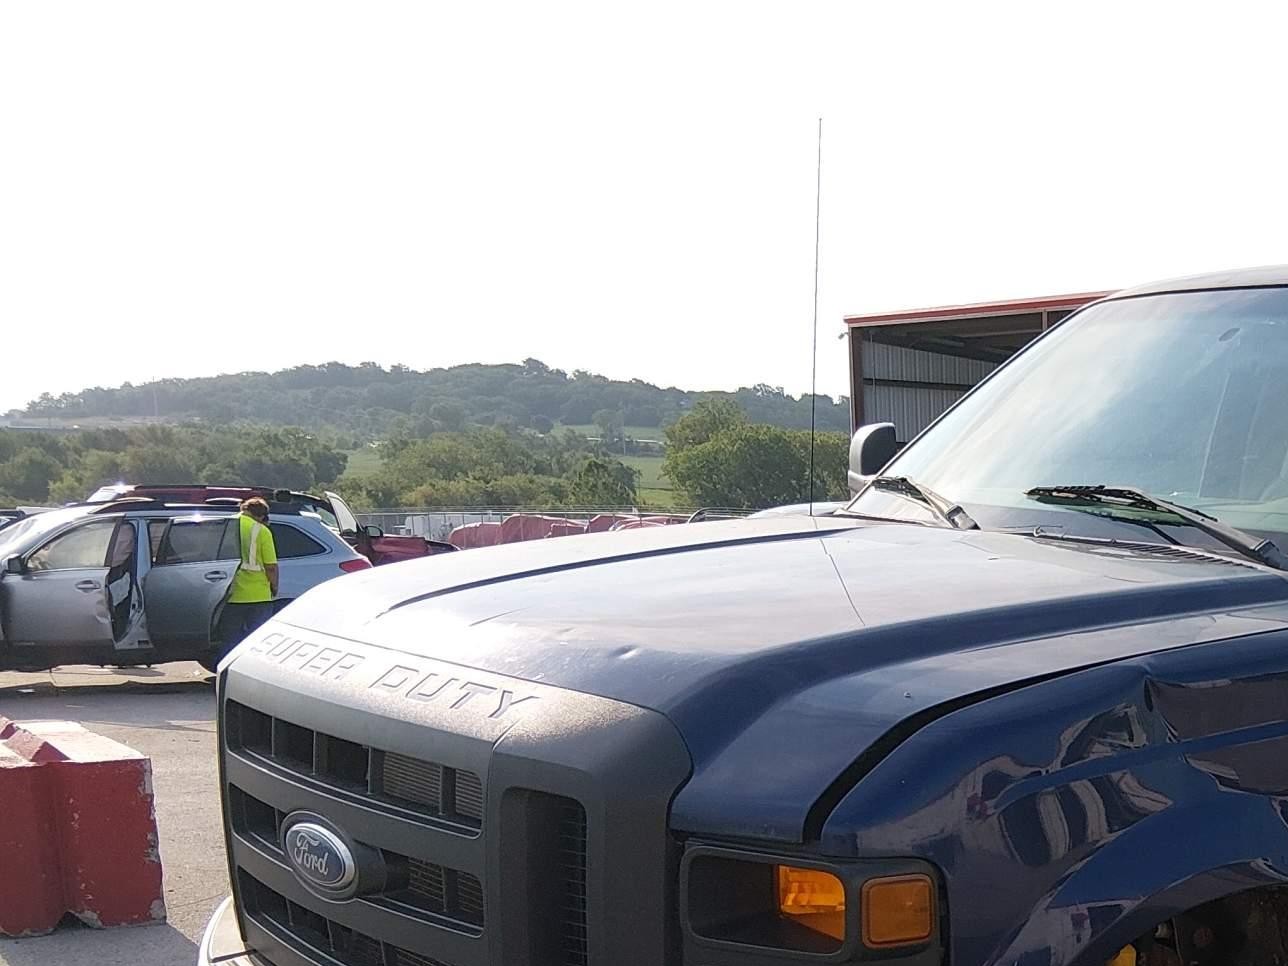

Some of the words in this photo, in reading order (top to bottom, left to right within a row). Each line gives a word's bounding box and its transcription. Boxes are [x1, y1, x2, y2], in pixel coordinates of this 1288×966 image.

[251, 632, 366, 681] SUPER
[368, 665, 539, 718] DUTY
[295, 833, 329, 876] Ford
